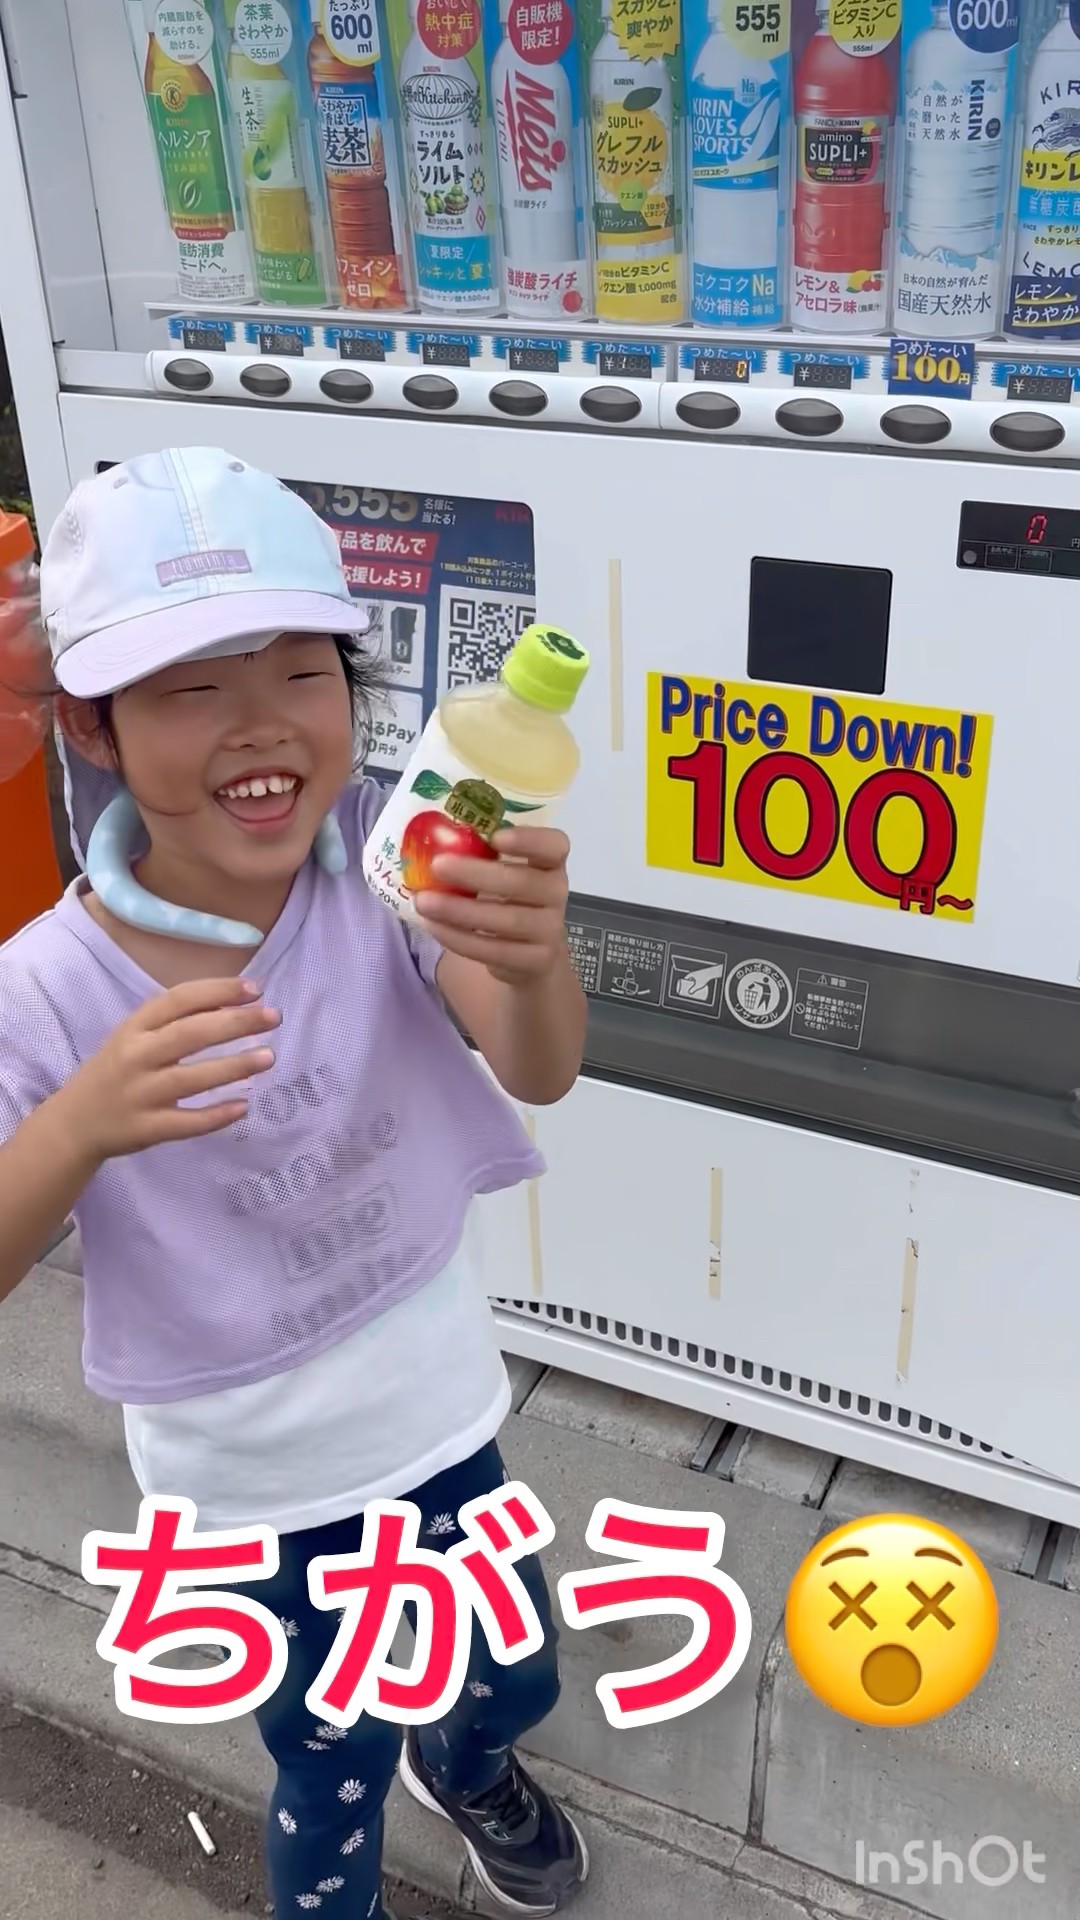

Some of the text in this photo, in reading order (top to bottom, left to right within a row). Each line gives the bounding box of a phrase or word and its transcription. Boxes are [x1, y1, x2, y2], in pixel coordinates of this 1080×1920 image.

[158, 11, 204, 23] 内臓脂肪を
[244, 3, 273, 21] 茶葉
[425, 11, 474, 31] 熱中症
[516, 2, 562, 27] 自販機
[736, 4, 781, 32] 555
[833, 4, 897, 25] ビタミンC
[957, 0, 1008, 30] 600
[162, 26, 204, 37] 減らすのを
[238, 23, 289, 40] さわやか
[330, 14, 372, 40] 600
[627, 15, 673, 39] 爽やか
[762, 31, 779, 43] ml
[853, 25, 876, 39] 入り
[357, 41, 372, 53] ml
[438, 34, 463, 48] 対策
[521, 28, 560, 50] 限定!
[250, 48, 280, 59] 555ml
[614, 78, 634, 86] KIRIN
[741, 78, 755, 93] Na
[242, 86, 260, 132] 生茶
[693, 98, 733, 118] KIRIN
[923, 94, 962, 108] 自然が
[967, 79, 985, 141] KIRIN
[693, 117, 738, 137] LOVES
[922, 111, 961, 124] 磨いた
[158, 129, 212, 150] ヘルシア
[496, 98, 508, 162] LITCHI
[515, 69, 558, 192] Mets
[819, 133, 853, 143] amino
[922, 128, 961, 140] 天然水
[323, 127, 367, 163] 麦茶
[417, 140, 464, 162] ライム
[597, 130, 663, 156] グレフル
[693, 136, 752, 155] SPORTS
[419, 164, 465, 185] ソルト
[598, 156, 662, 176] スカッシュ
[179, 242, 225, 259] 脂肪消費
[430, 244, 464, 260] 夏限定
[346, 281, 372, 297] ゼロ
[508, 267, 578, 291] 強炭酸ライチ
[695, 272, 775, 298] ゴクゴク Na
[795, 271, 840, 294] レモン&
[903, 273, 989, 289] 日本の自然が育んだ
[660, 293, 678, 304] 配合
[694, 295, 749, 316] 水分補給
[898, 289, 992, 316] 国産天然水
[1012, 304, 1080, 324] さわやか
[424, 498, 454, 511] 名様に
[421, 511, 456, 525] 当たる!
[1026, 513, 1048, 544] 0
[661, 675, 978, 779] Price Down!
[667, 740, 958, 900] 100
[735, 962, 786, 990] のんだあとは
[734, 1003, 779, 1024] リサイクル
